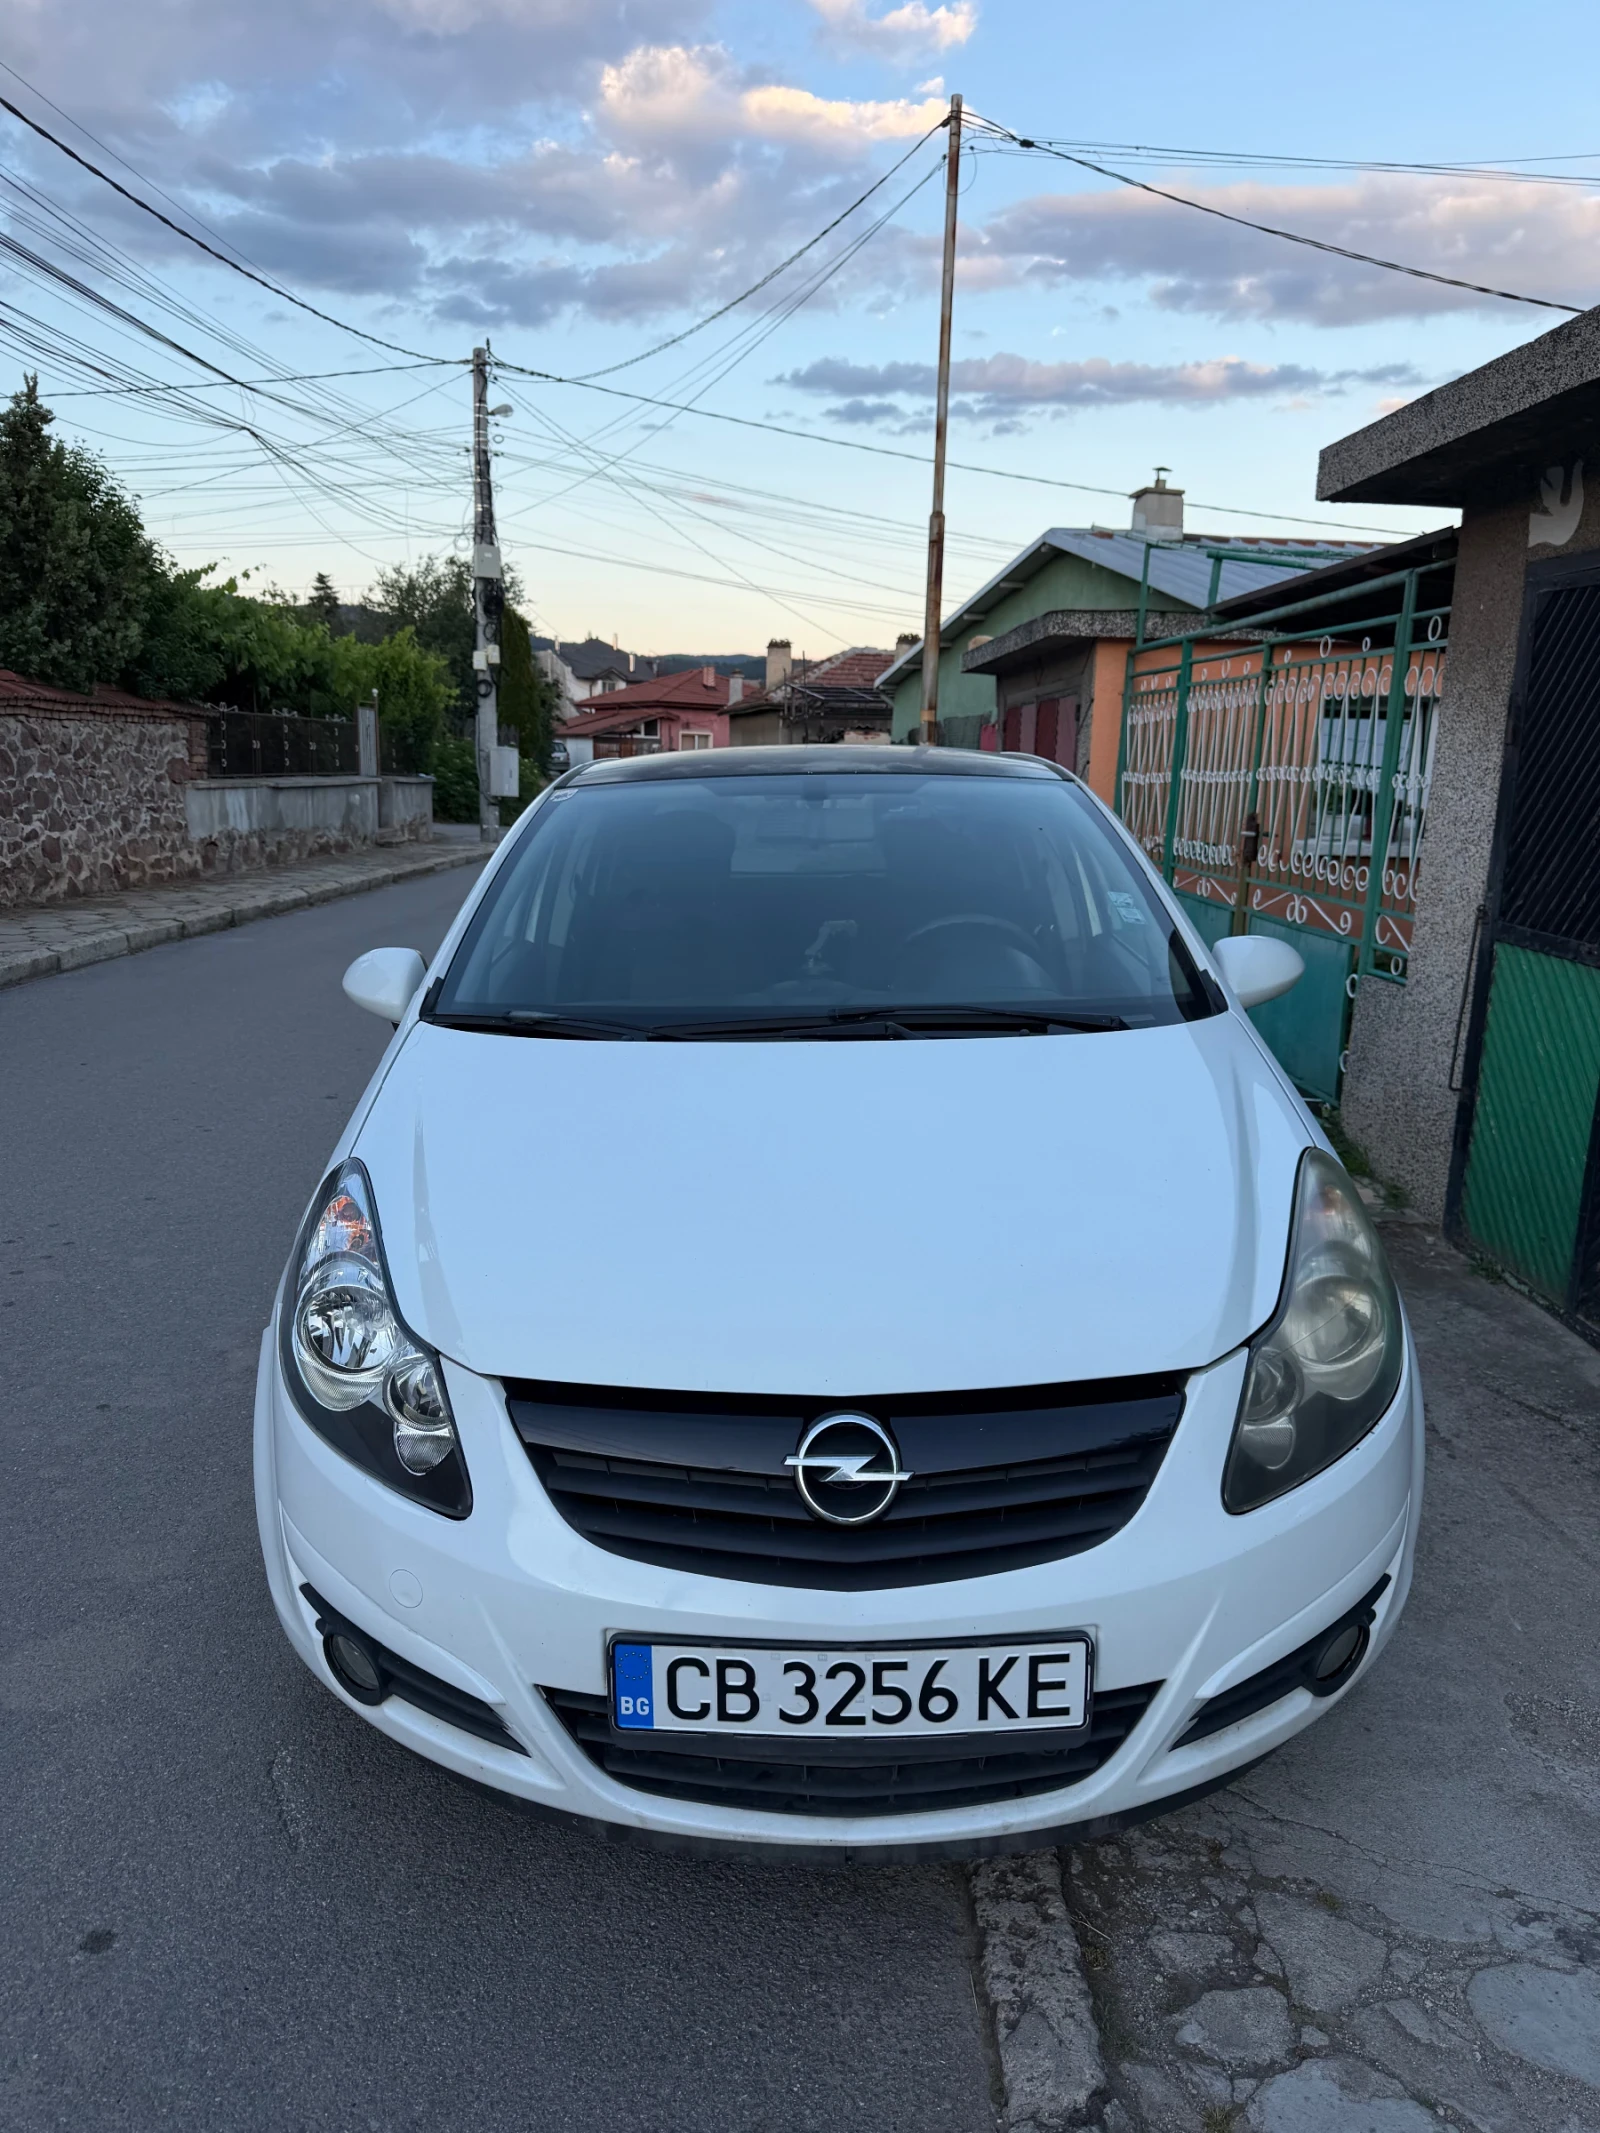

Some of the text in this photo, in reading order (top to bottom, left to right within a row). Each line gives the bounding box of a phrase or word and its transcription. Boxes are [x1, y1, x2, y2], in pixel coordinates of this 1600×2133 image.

[620, 1696, 650, 1716] BG
[666, 1651, 1071, 1725] CB 3256 KE
